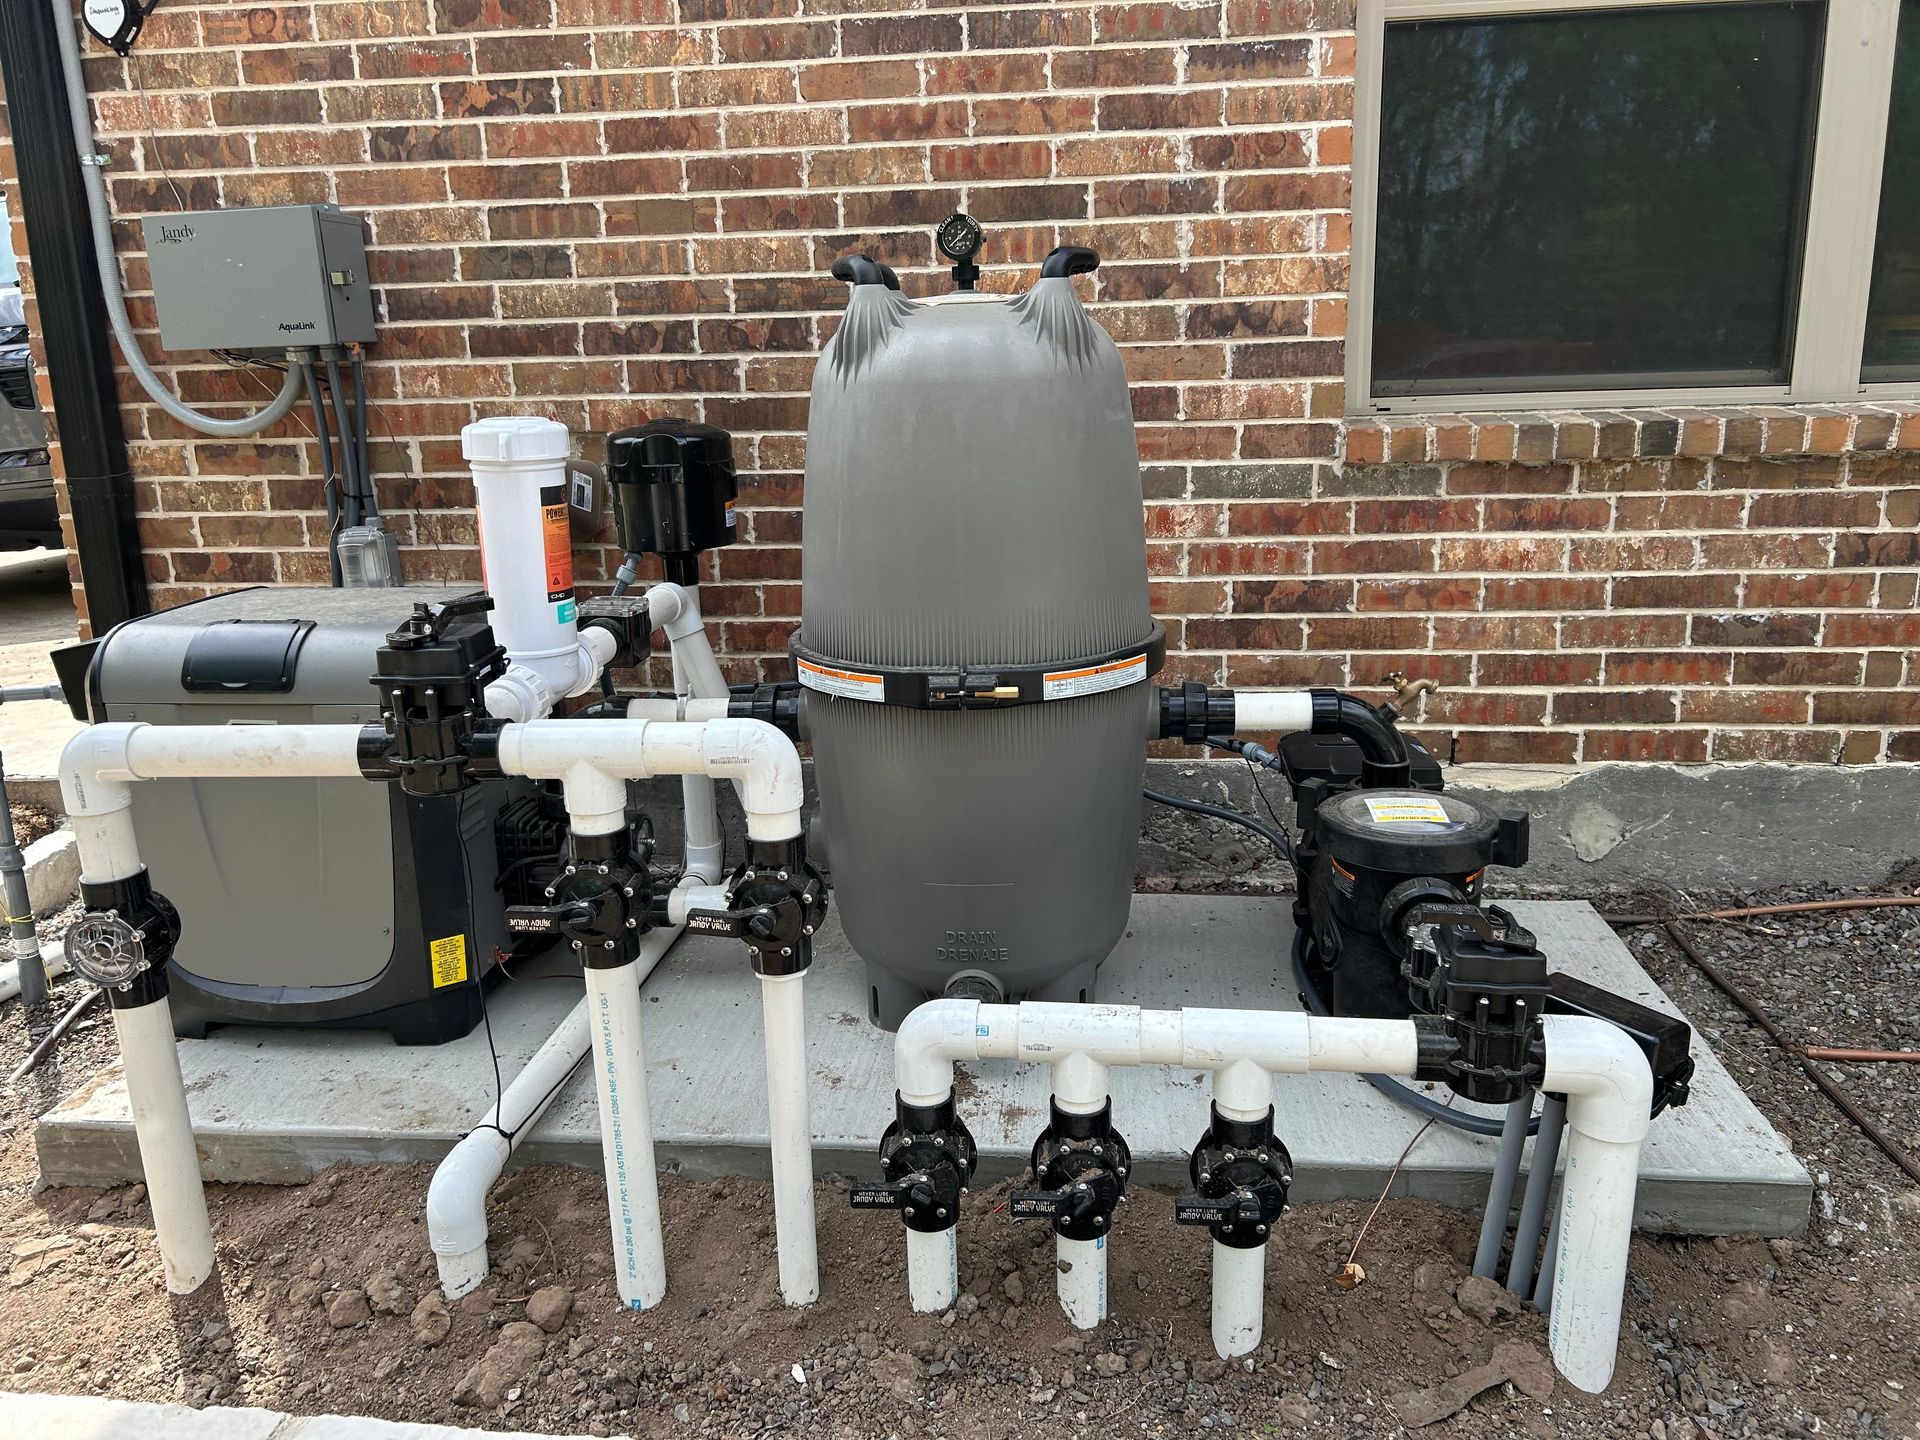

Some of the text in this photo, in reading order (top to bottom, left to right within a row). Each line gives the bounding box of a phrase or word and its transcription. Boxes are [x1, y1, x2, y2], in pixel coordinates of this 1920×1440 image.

[92, 6, 119, 15] AquaLink
[155, 224, 195, 244] Jandy
[278, 321, 316, 334] AquaLink
[509, 918, 552, 927] JANDY VALVE
[688, 919, 731, 932] JANDY VALVE
[945, 930, 997, 944] DRAIN
[937, 946, 1009, 961] DRENAJE
[601, 992, 609, 1009] UG-1
[612, 1095, 620, 1115] D2665
[617, 1150, 625, 1171] ASTM
[619, 1171, 627, 1186] 1120
[620, 1187, 629, 1203] PVC
[852, 1195, 895, 1204] JANDY VALVE
[1035, 1205, 1057, 1213] VALVE
[624, 1217, 633, 1226] @
[1178, 1212, 1223, 1221] JANDY VALVE
[625, 1235, 633, 1247] 280
[627, 1247, 634, 1256] 40
[628, 1257, 636, 1272] SCH
